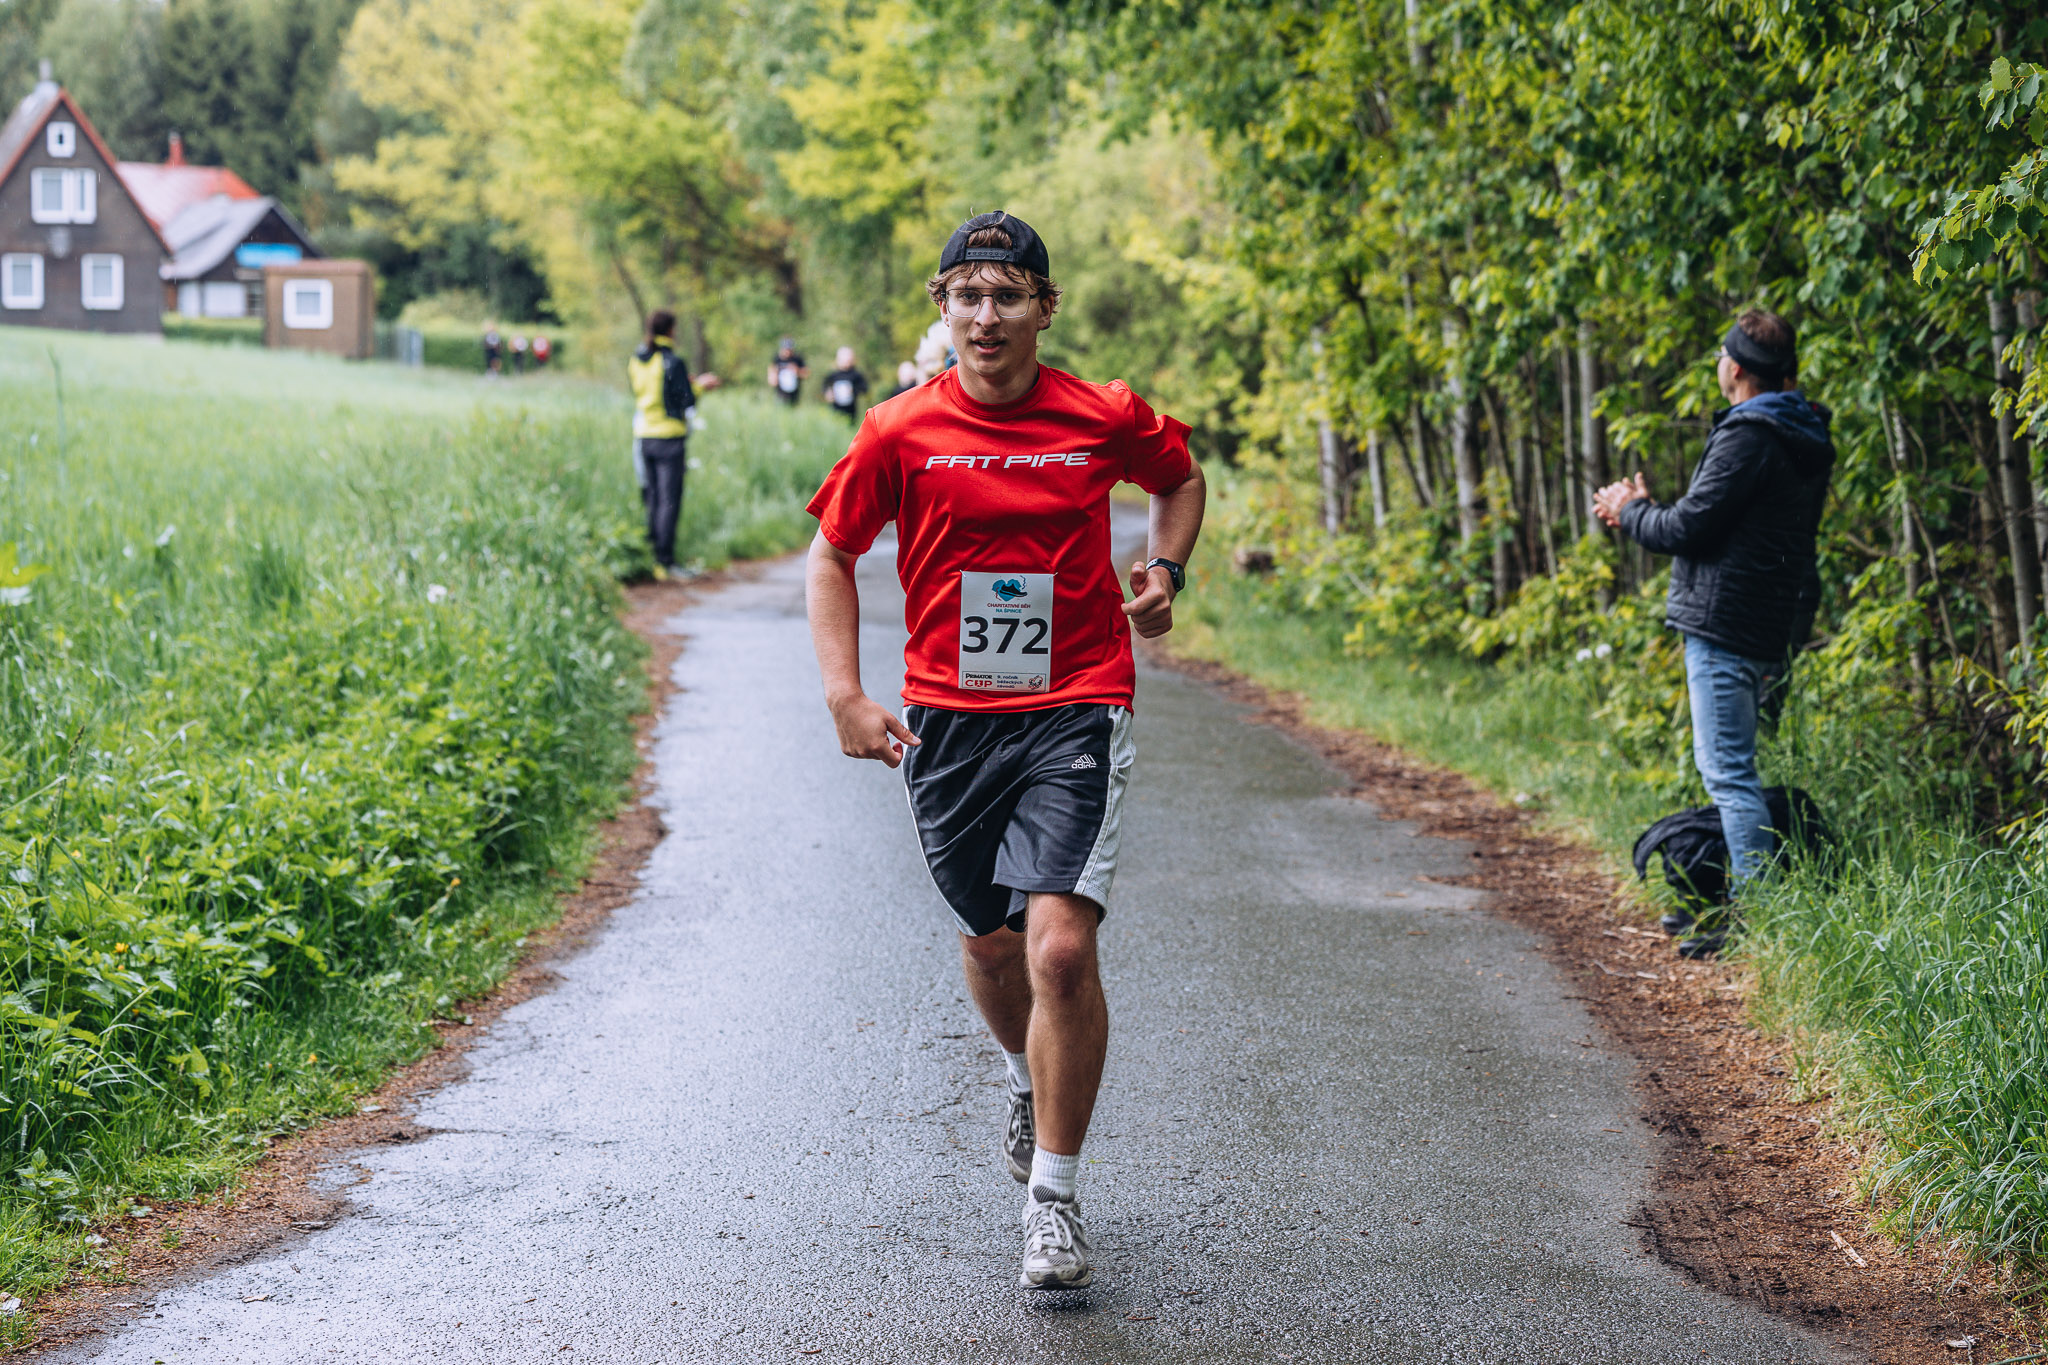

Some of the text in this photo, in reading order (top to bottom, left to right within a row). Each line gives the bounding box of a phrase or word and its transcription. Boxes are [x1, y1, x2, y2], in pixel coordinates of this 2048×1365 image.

[925, 452, 1092, 470] FAT PIPE
[962, 615, 1049, 655] 372
[965, 679, 993, 688] CUP
